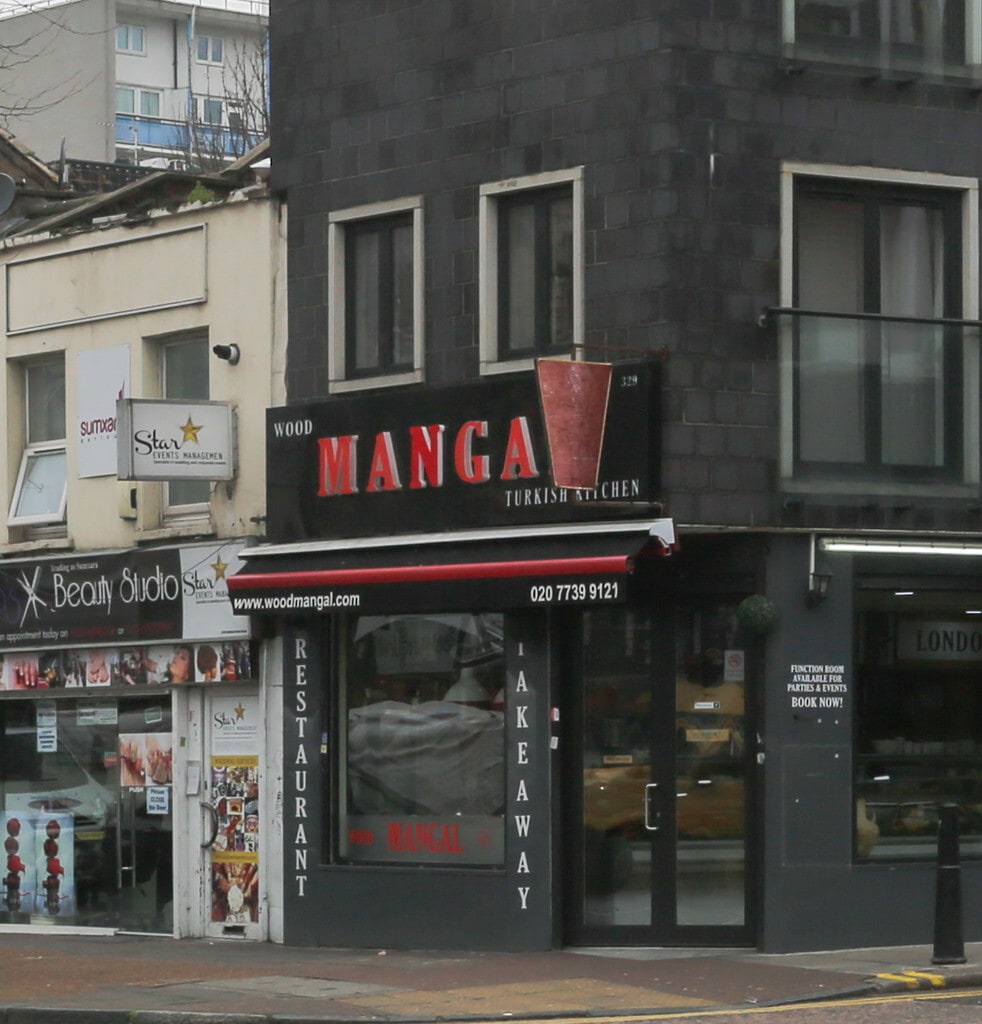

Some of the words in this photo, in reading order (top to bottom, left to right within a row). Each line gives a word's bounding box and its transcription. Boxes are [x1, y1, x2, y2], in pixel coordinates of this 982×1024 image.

[621, 375, 638, 387] 329
[134, 429, 181, 456] Star
[274, 420, 313, 438] WOOD
[153, 451, 179, 460] EVENTS
[317, 416, 540, 498] MANGA
[505, 488, 568, 508] TURKISH
[575, 479, 640, 501] KITCHEN
[51, 573, 114, 615] Beauty
[120, 565, 179, 604] Studio
[182, 570, 214, 597] Star
[233, 590, 361, 613] www.woodmangal.com
[530, 584, 554, 603] 020
[557, 583, 587, 602] 7739
[589, 581, 619, 601] 9121
[791, 665, 824, 673] FUNCTION
[825, 665, 845, 673] ROOM
[793, 674, 828, 682] AVAILABLE
[829, 674, 842, 682] FOR
[787, 684, 815, 692] PARTIES
[822, 684, 847, 692] EVENTS
[791, 697, 817, 707] BOOK
[819, 697, 843, 708] NOW!
[294, 638, 308, 897] RESTAURANT
[388, 822, 463, 853] MANGAL
